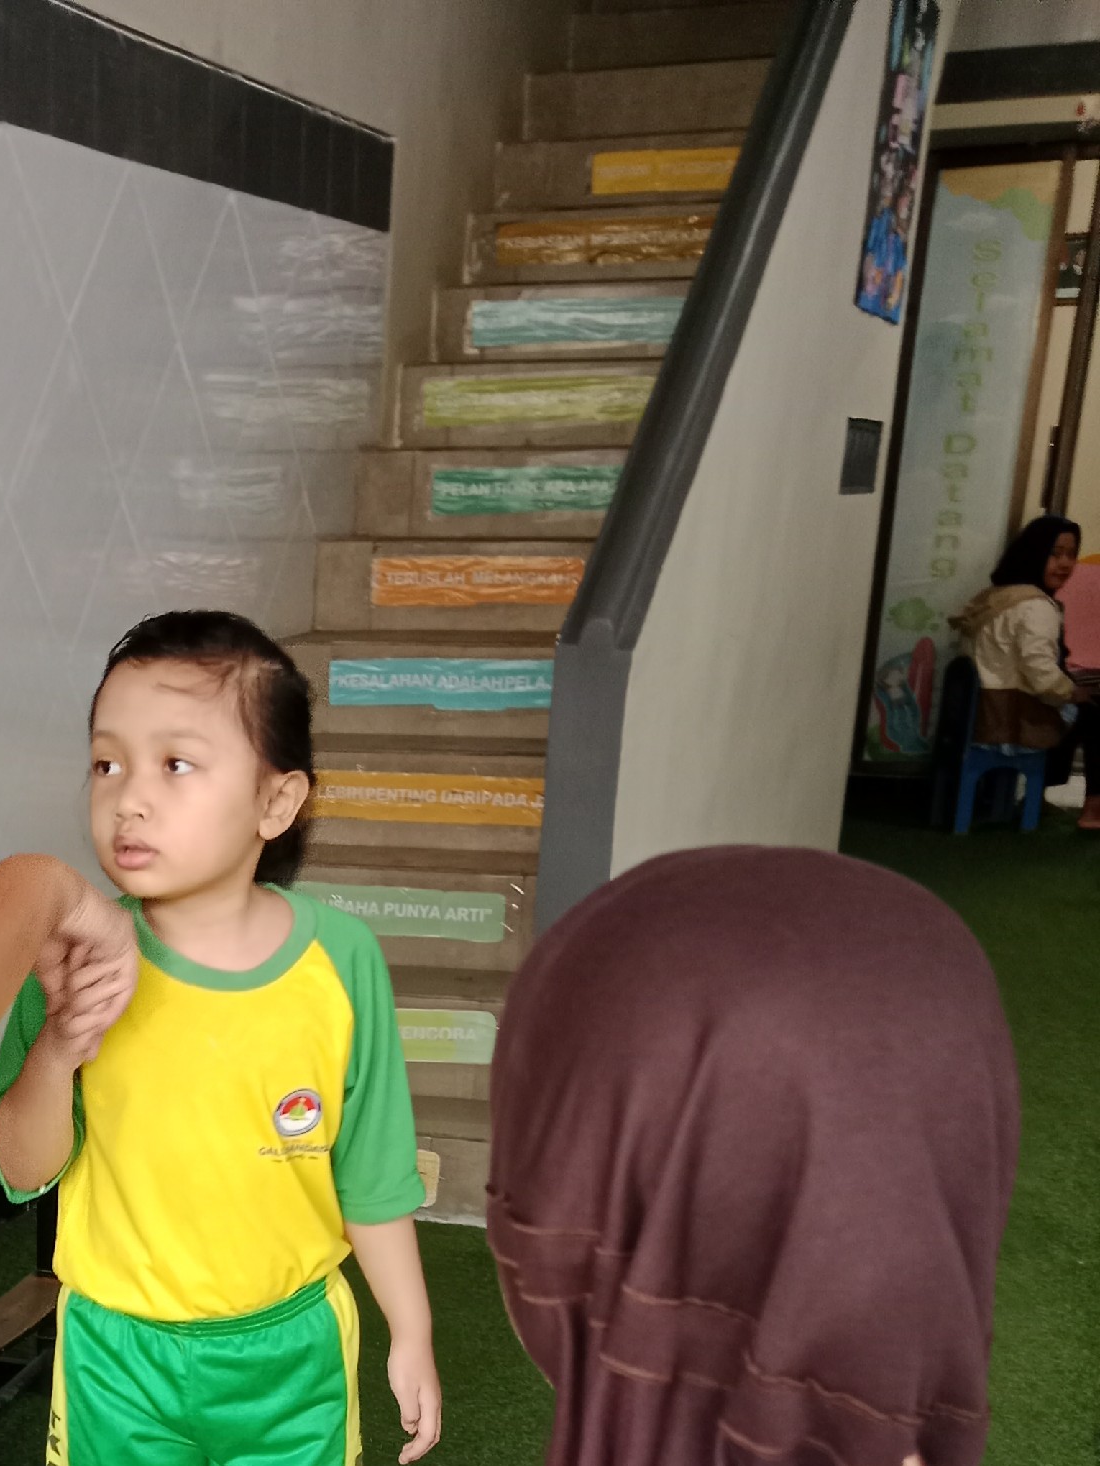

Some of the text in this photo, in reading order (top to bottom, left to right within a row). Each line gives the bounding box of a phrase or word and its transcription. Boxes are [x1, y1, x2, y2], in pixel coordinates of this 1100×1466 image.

[930, 432, 977, 579] Datang
[363, 787, 437, 803] PENTING
[440, 790, 528, 808] DARIPADA
[383, 902, 441, 919] PUNYA
